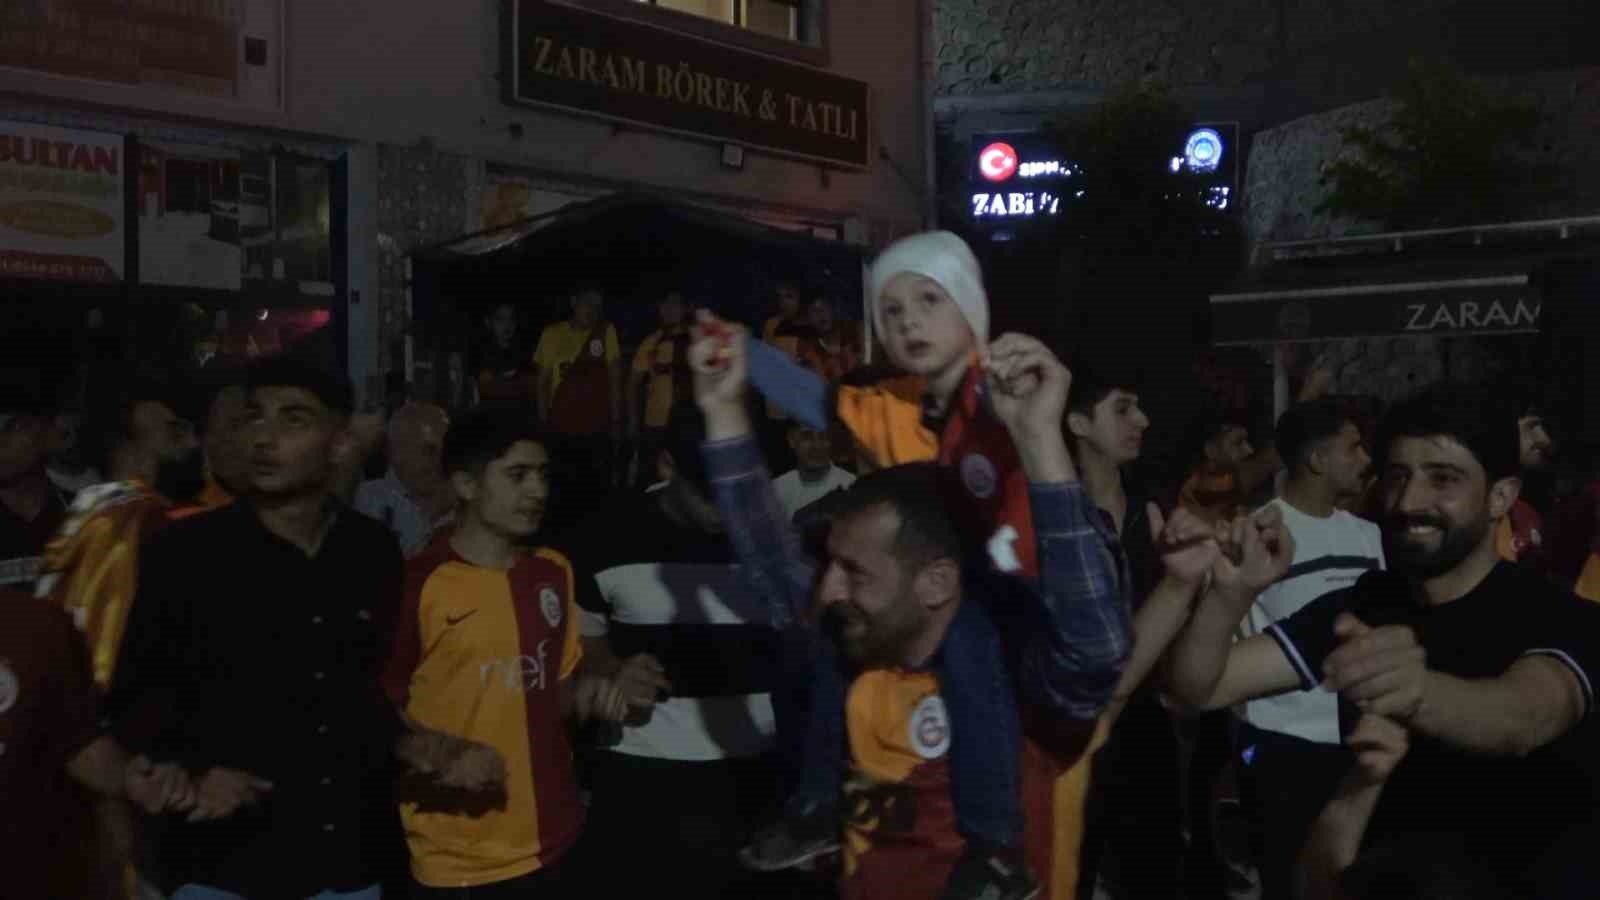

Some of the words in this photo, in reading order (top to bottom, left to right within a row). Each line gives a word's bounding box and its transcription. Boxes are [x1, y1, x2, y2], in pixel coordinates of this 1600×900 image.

[534, 35, 646, 94] ZARAM
[655, 58, 752, 119] BÖREK
[758, 88, 777, 120] &
[784, 92, 857, 140] TATLI
